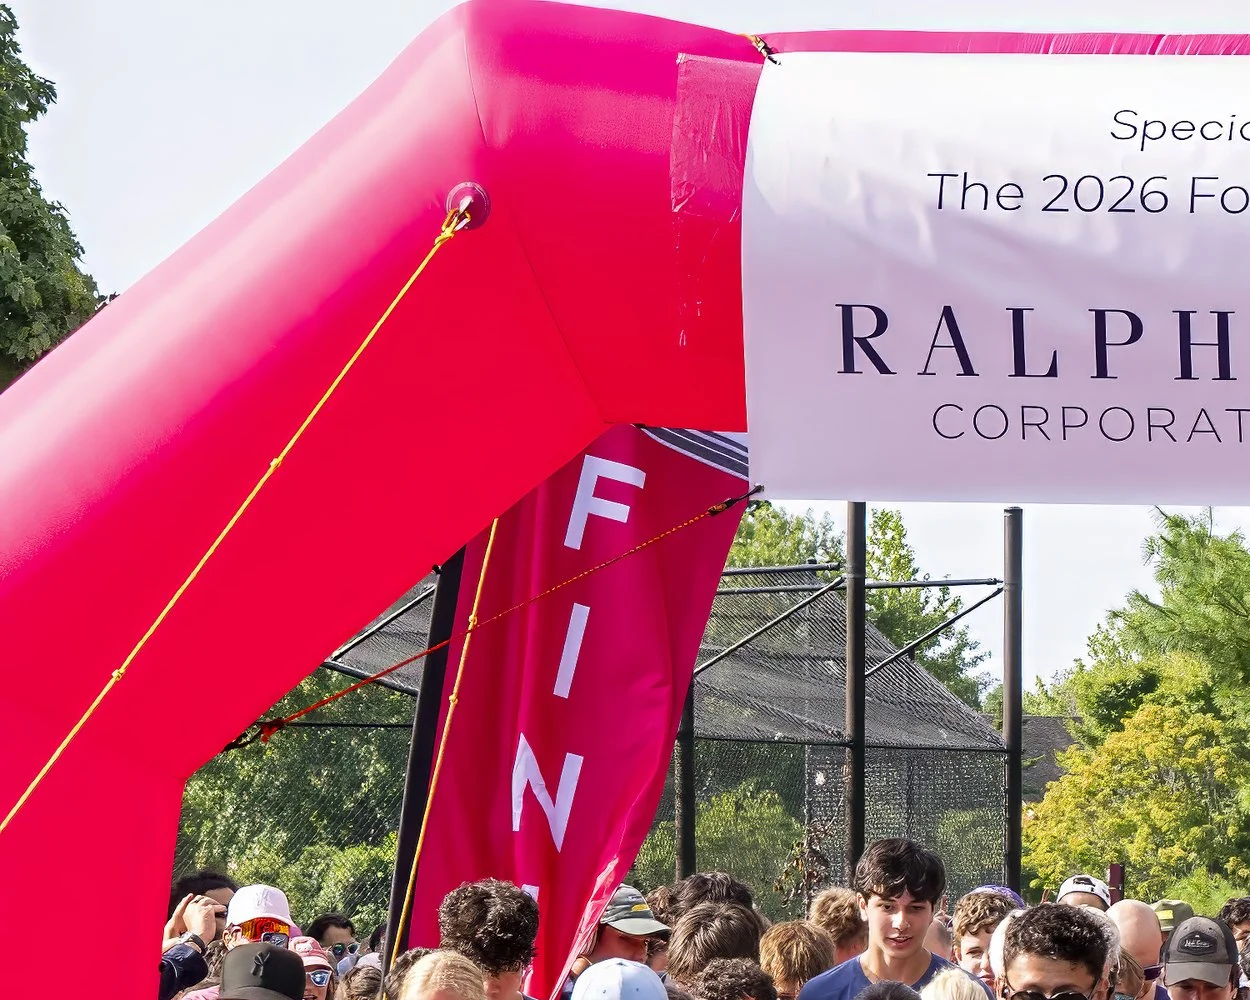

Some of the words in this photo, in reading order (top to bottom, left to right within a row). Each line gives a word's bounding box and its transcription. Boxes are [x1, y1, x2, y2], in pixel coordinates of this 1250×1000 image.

[927, 172, 1024, 210] The
[1041, 174, 1169, 214] 2026
[835, 303, 1237, 381] RALPH
[511, 453, 647, 902] FIN
